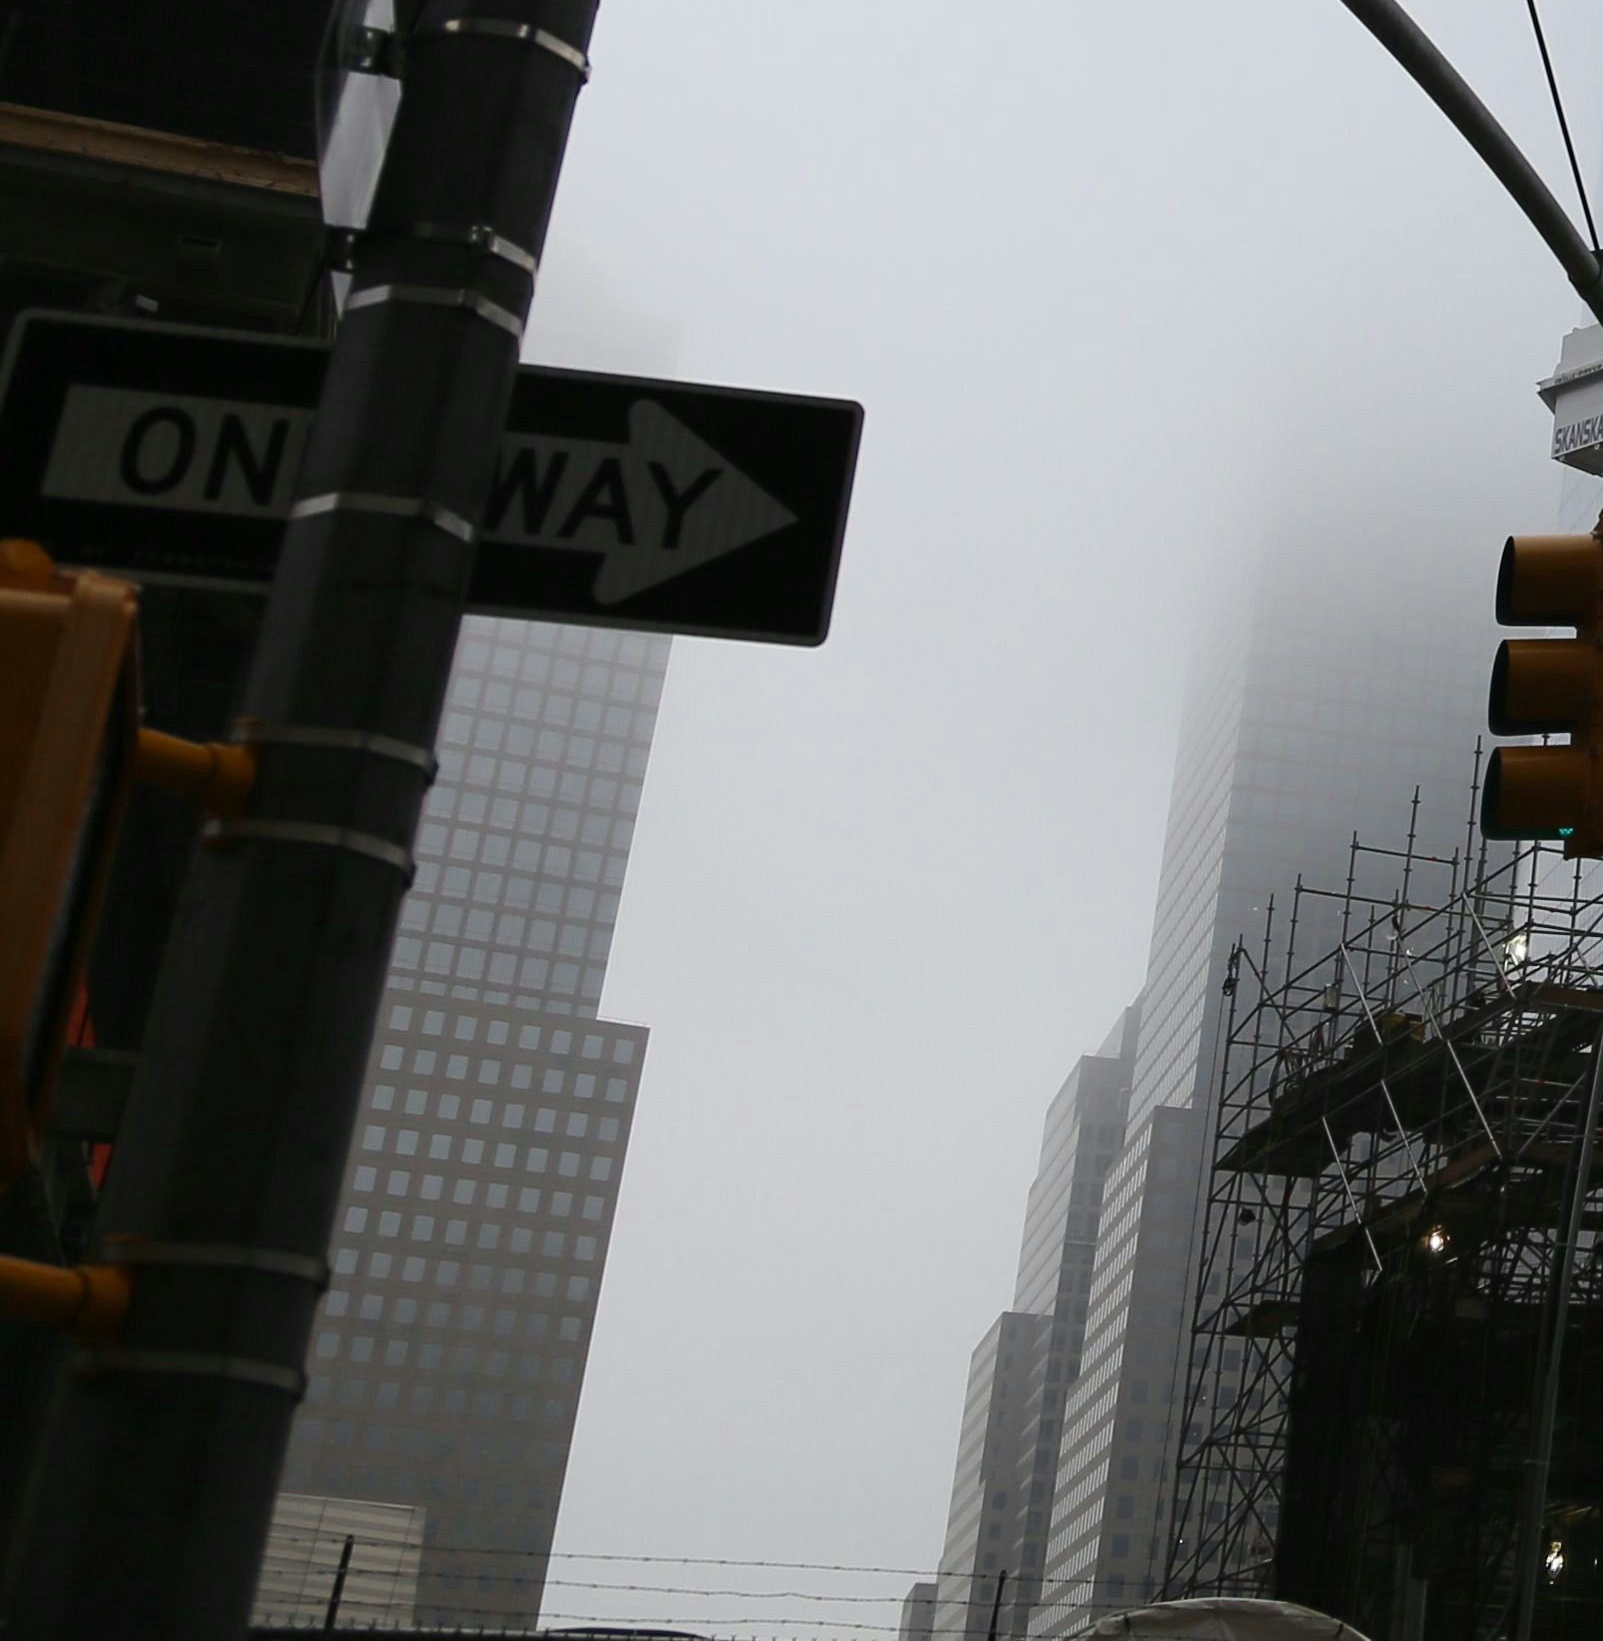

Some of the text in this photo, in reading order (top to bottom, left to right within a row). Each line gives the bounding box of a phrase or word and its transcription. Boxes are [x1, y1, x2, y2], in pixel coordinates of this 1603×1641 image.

[120, 407, 724, 550] ON WAY
[1555, 414, 1603, 453] SKANSKA
